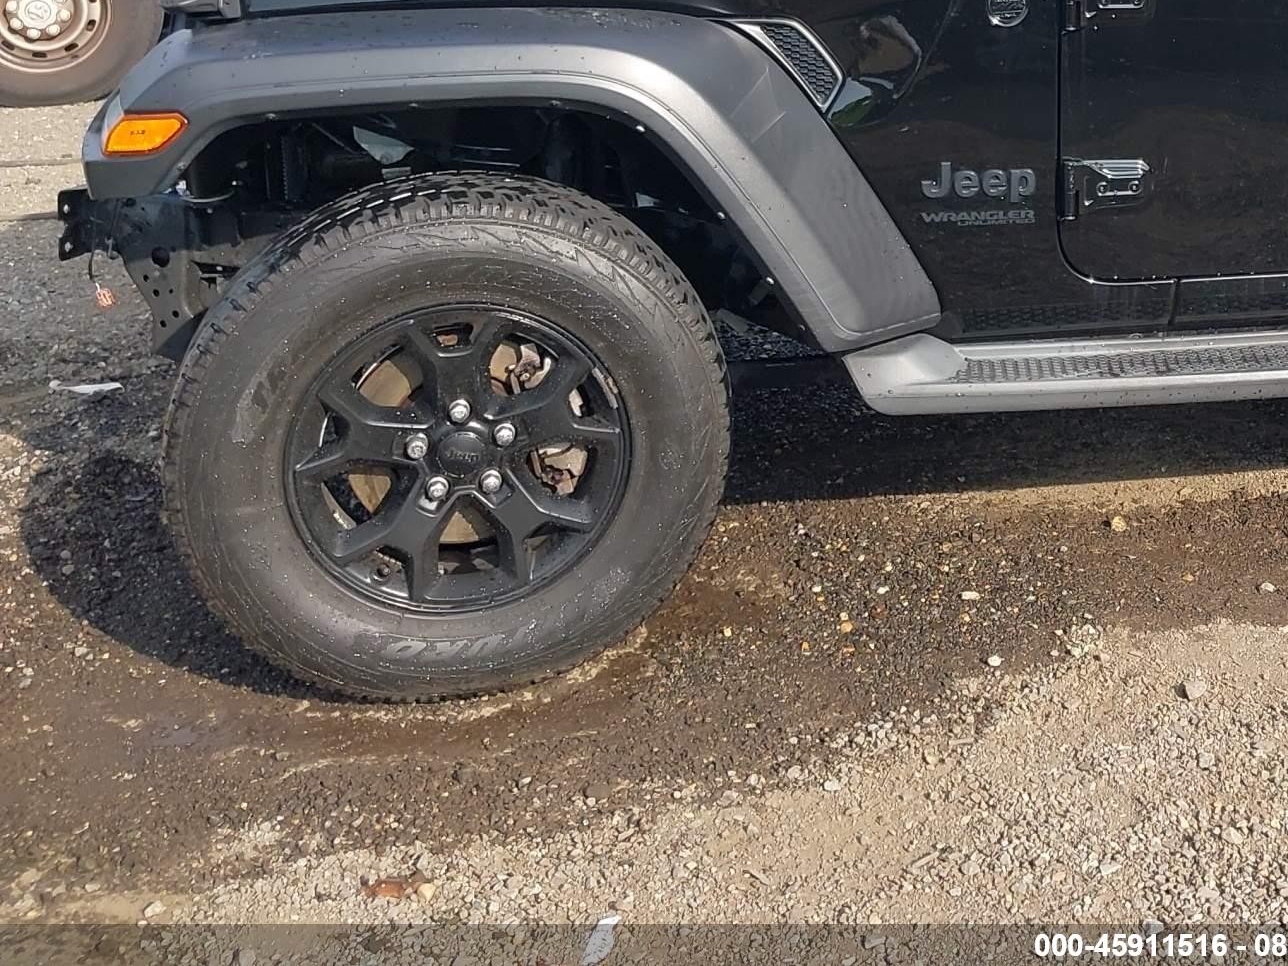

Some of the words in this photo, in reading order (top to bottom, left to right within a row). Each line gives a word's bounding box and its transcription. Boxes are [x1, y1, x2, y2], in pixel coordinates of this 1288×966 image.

[921, 161, 1037, 203] Jeep
[920, 209, 1036, 224] WRANGLER
[957, 218, 1036, 226] UNLIMITED
